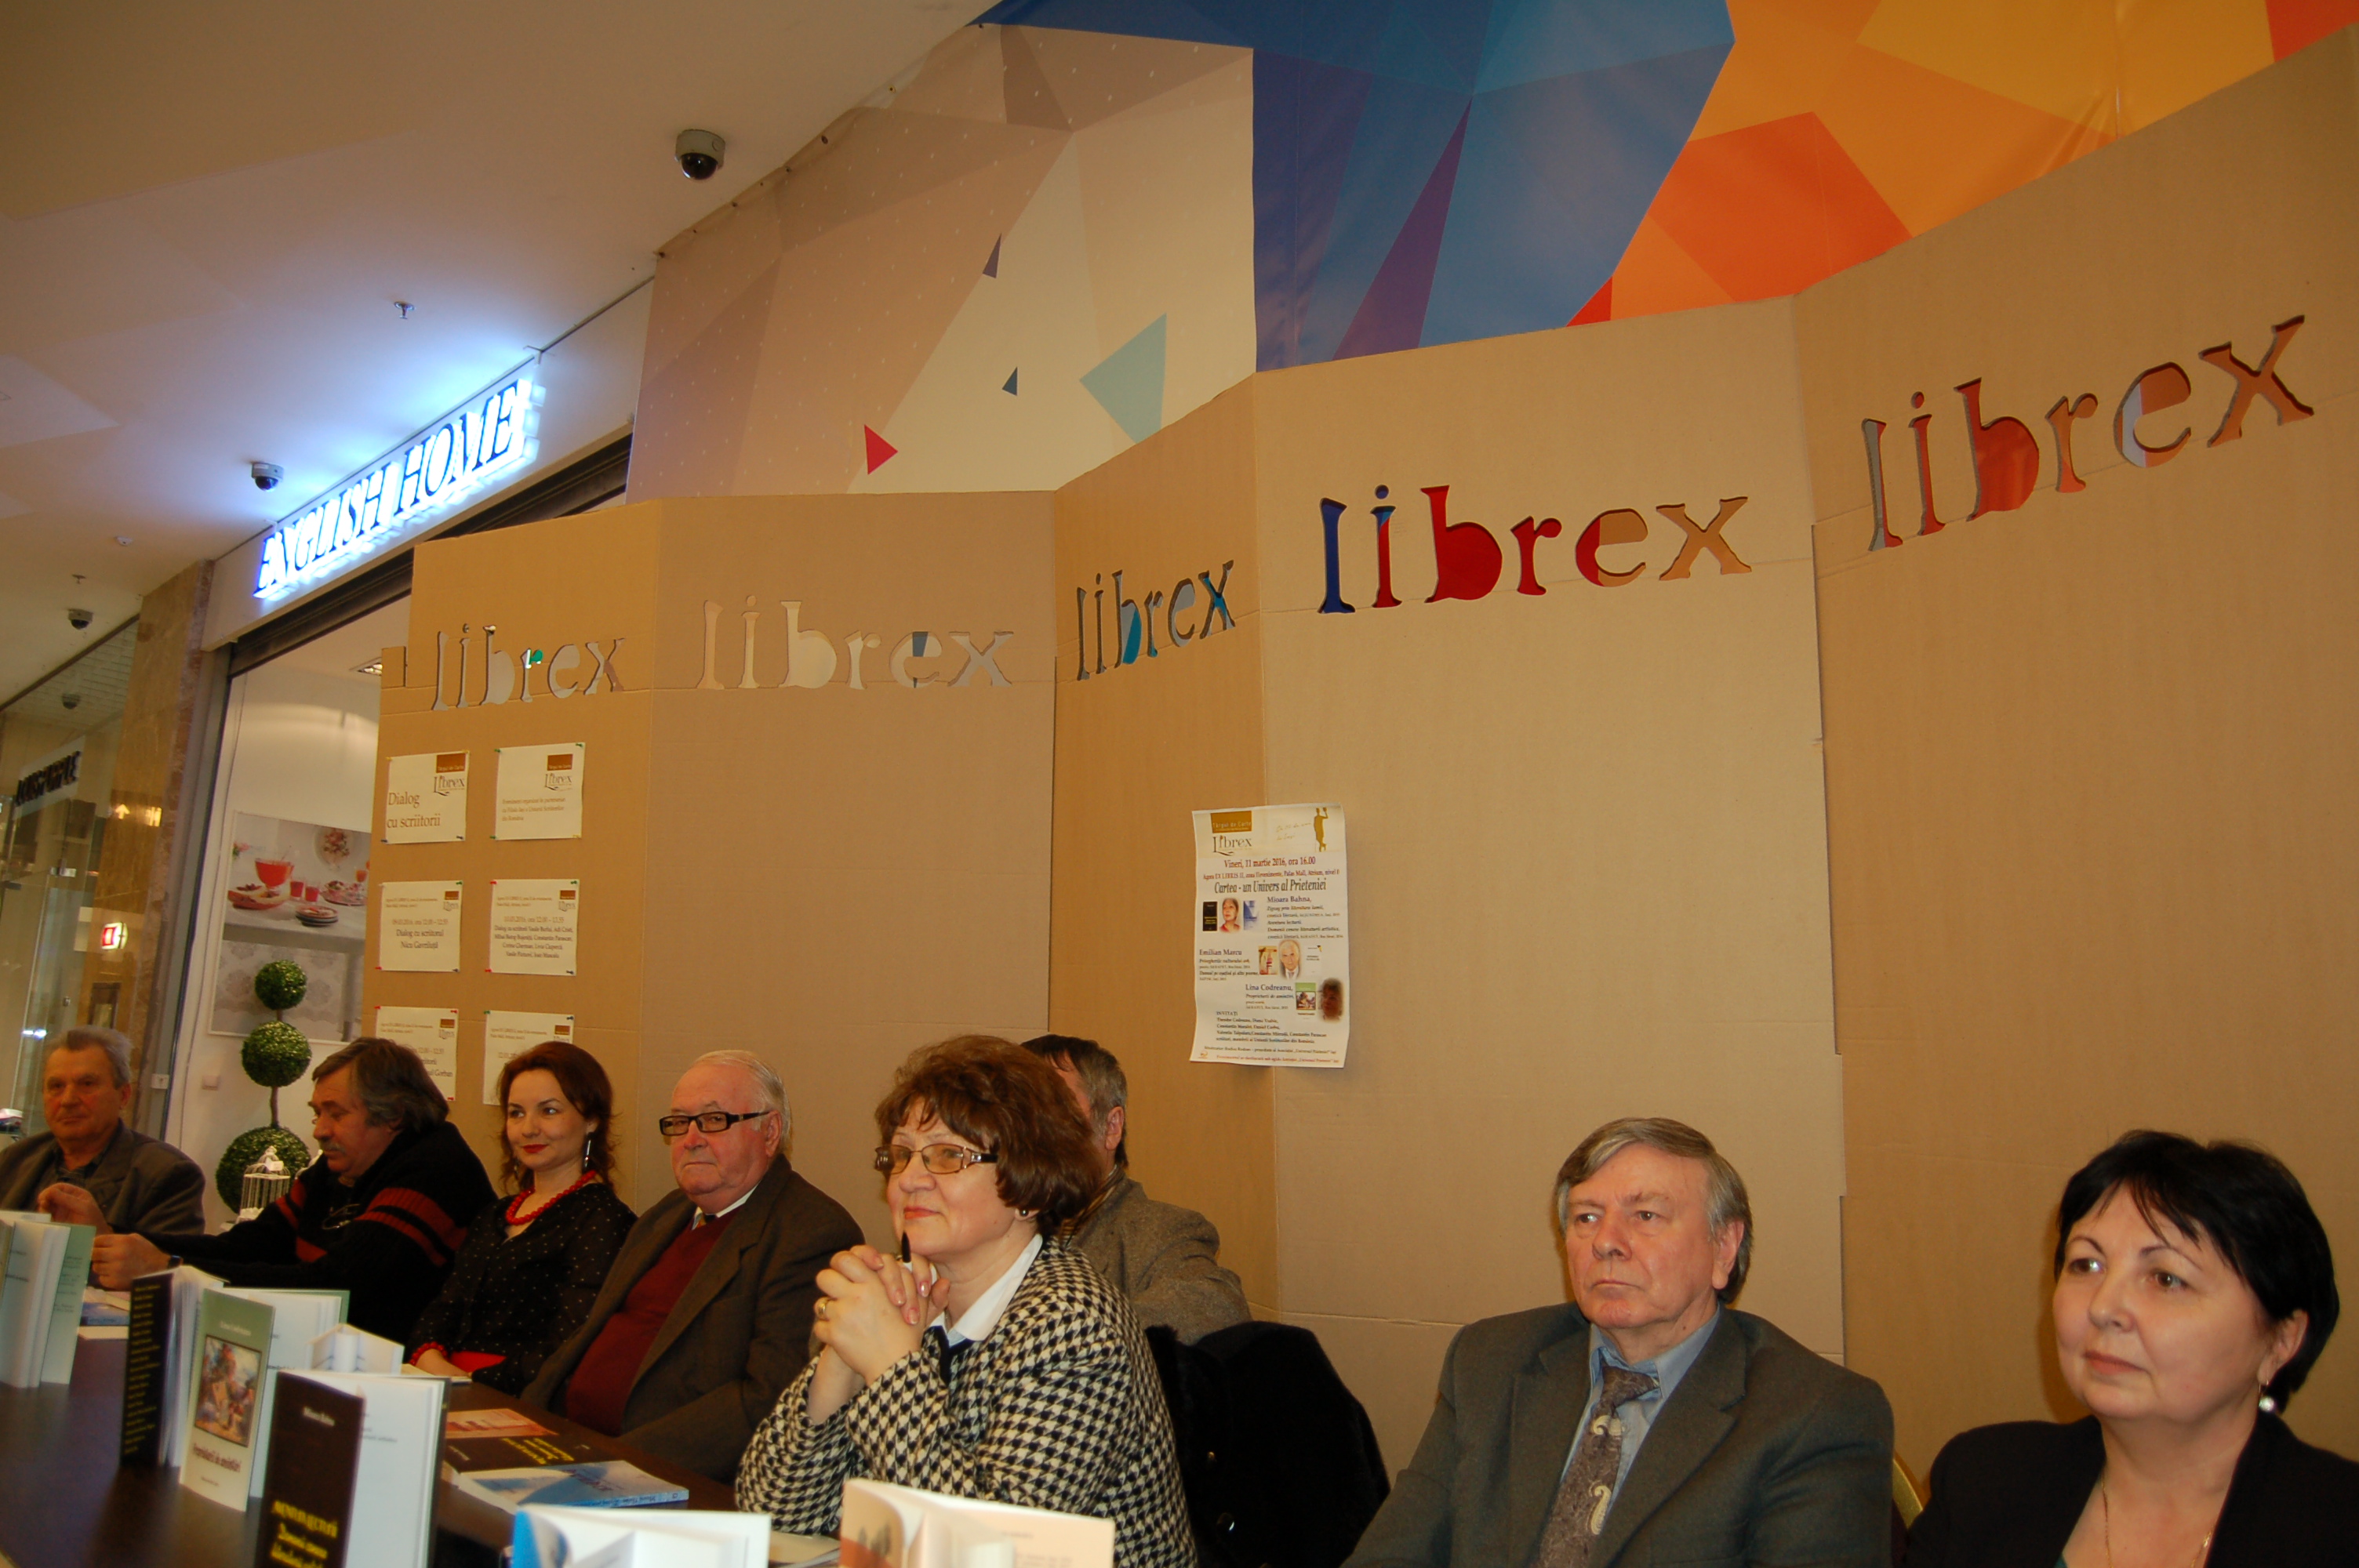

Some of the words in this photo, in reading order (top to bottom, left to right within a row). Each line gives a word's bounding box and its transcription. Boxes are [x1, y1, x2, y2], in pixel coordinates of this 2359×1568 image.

[1862, 314, 2314, 551] librex
[253, 461, 402, 600] ENGLISH
[394, 379, 535, 521] HOME
[1318, 485, 1752, 614] librex
[696, 595, 1014, 690] librex
[1077, 560, 1235, 681] librex
[431, 623, 625, 711] librex
[387, 818, 398, 828] cu
[400, 813, 441, 828] scriitorii
[388, 791, 420, 808] Dialog
[1212, 835, 1252, 856] Librex
[1214, 880, 1238, 894] Cartea
[1243, 884, 1252, 893] un
[1253, 880, 1280, 893] Univers
[1281, 878, 1289, 891] al
[1290, 877, 1327, 891] Prieteniei
[1224, 859, 1244, 869] Vineri,
[1252, 858, 1270, 868] martie
